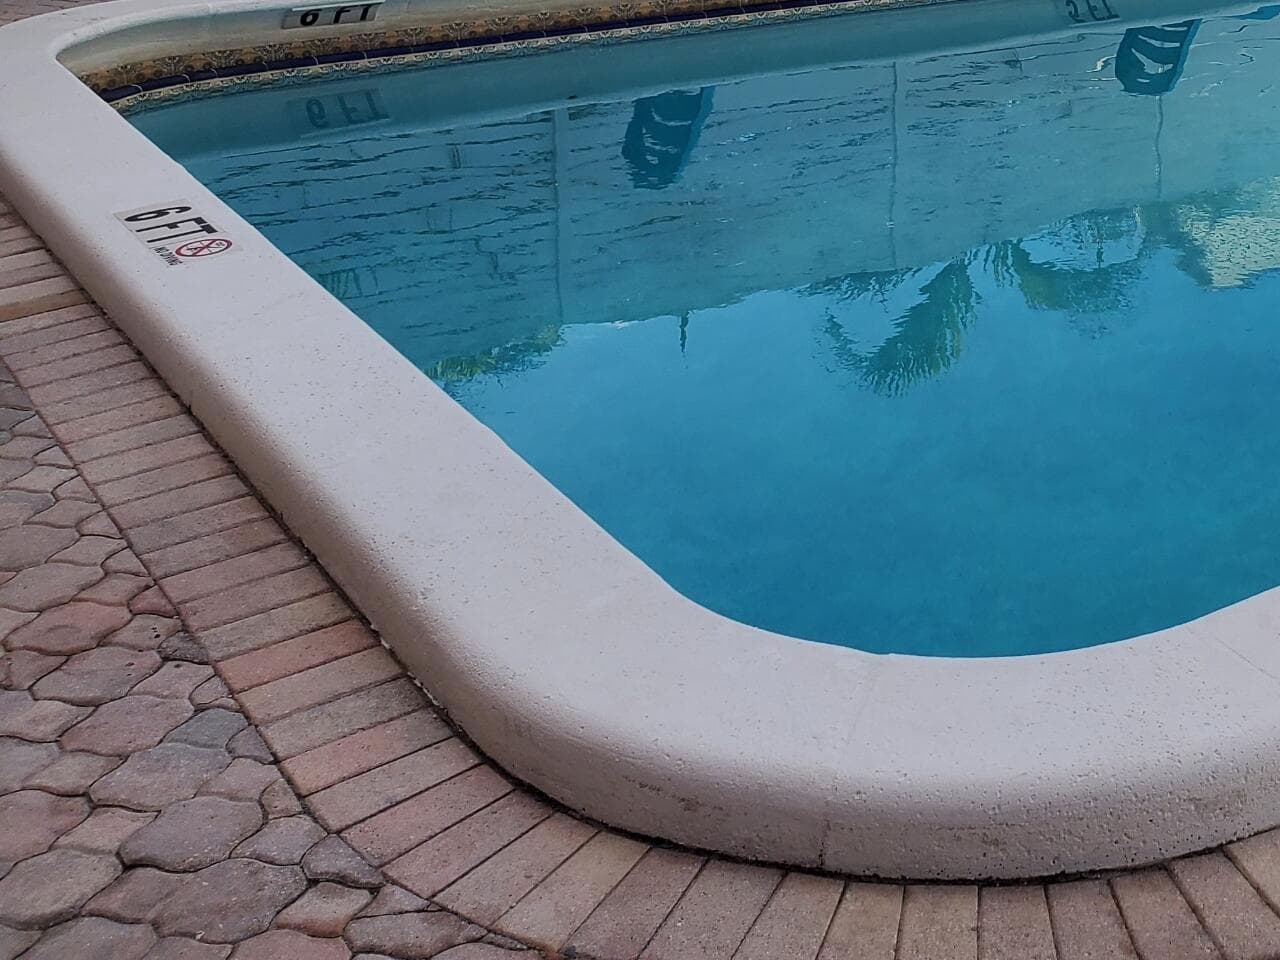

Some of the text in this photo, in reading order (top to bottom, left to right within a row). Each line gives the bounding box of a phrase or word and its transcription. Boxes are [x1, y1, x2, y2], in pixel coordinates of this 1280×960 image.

[300, 2, 383, 26] 6 FT
[124, 206, 218, 243] 6 FT
